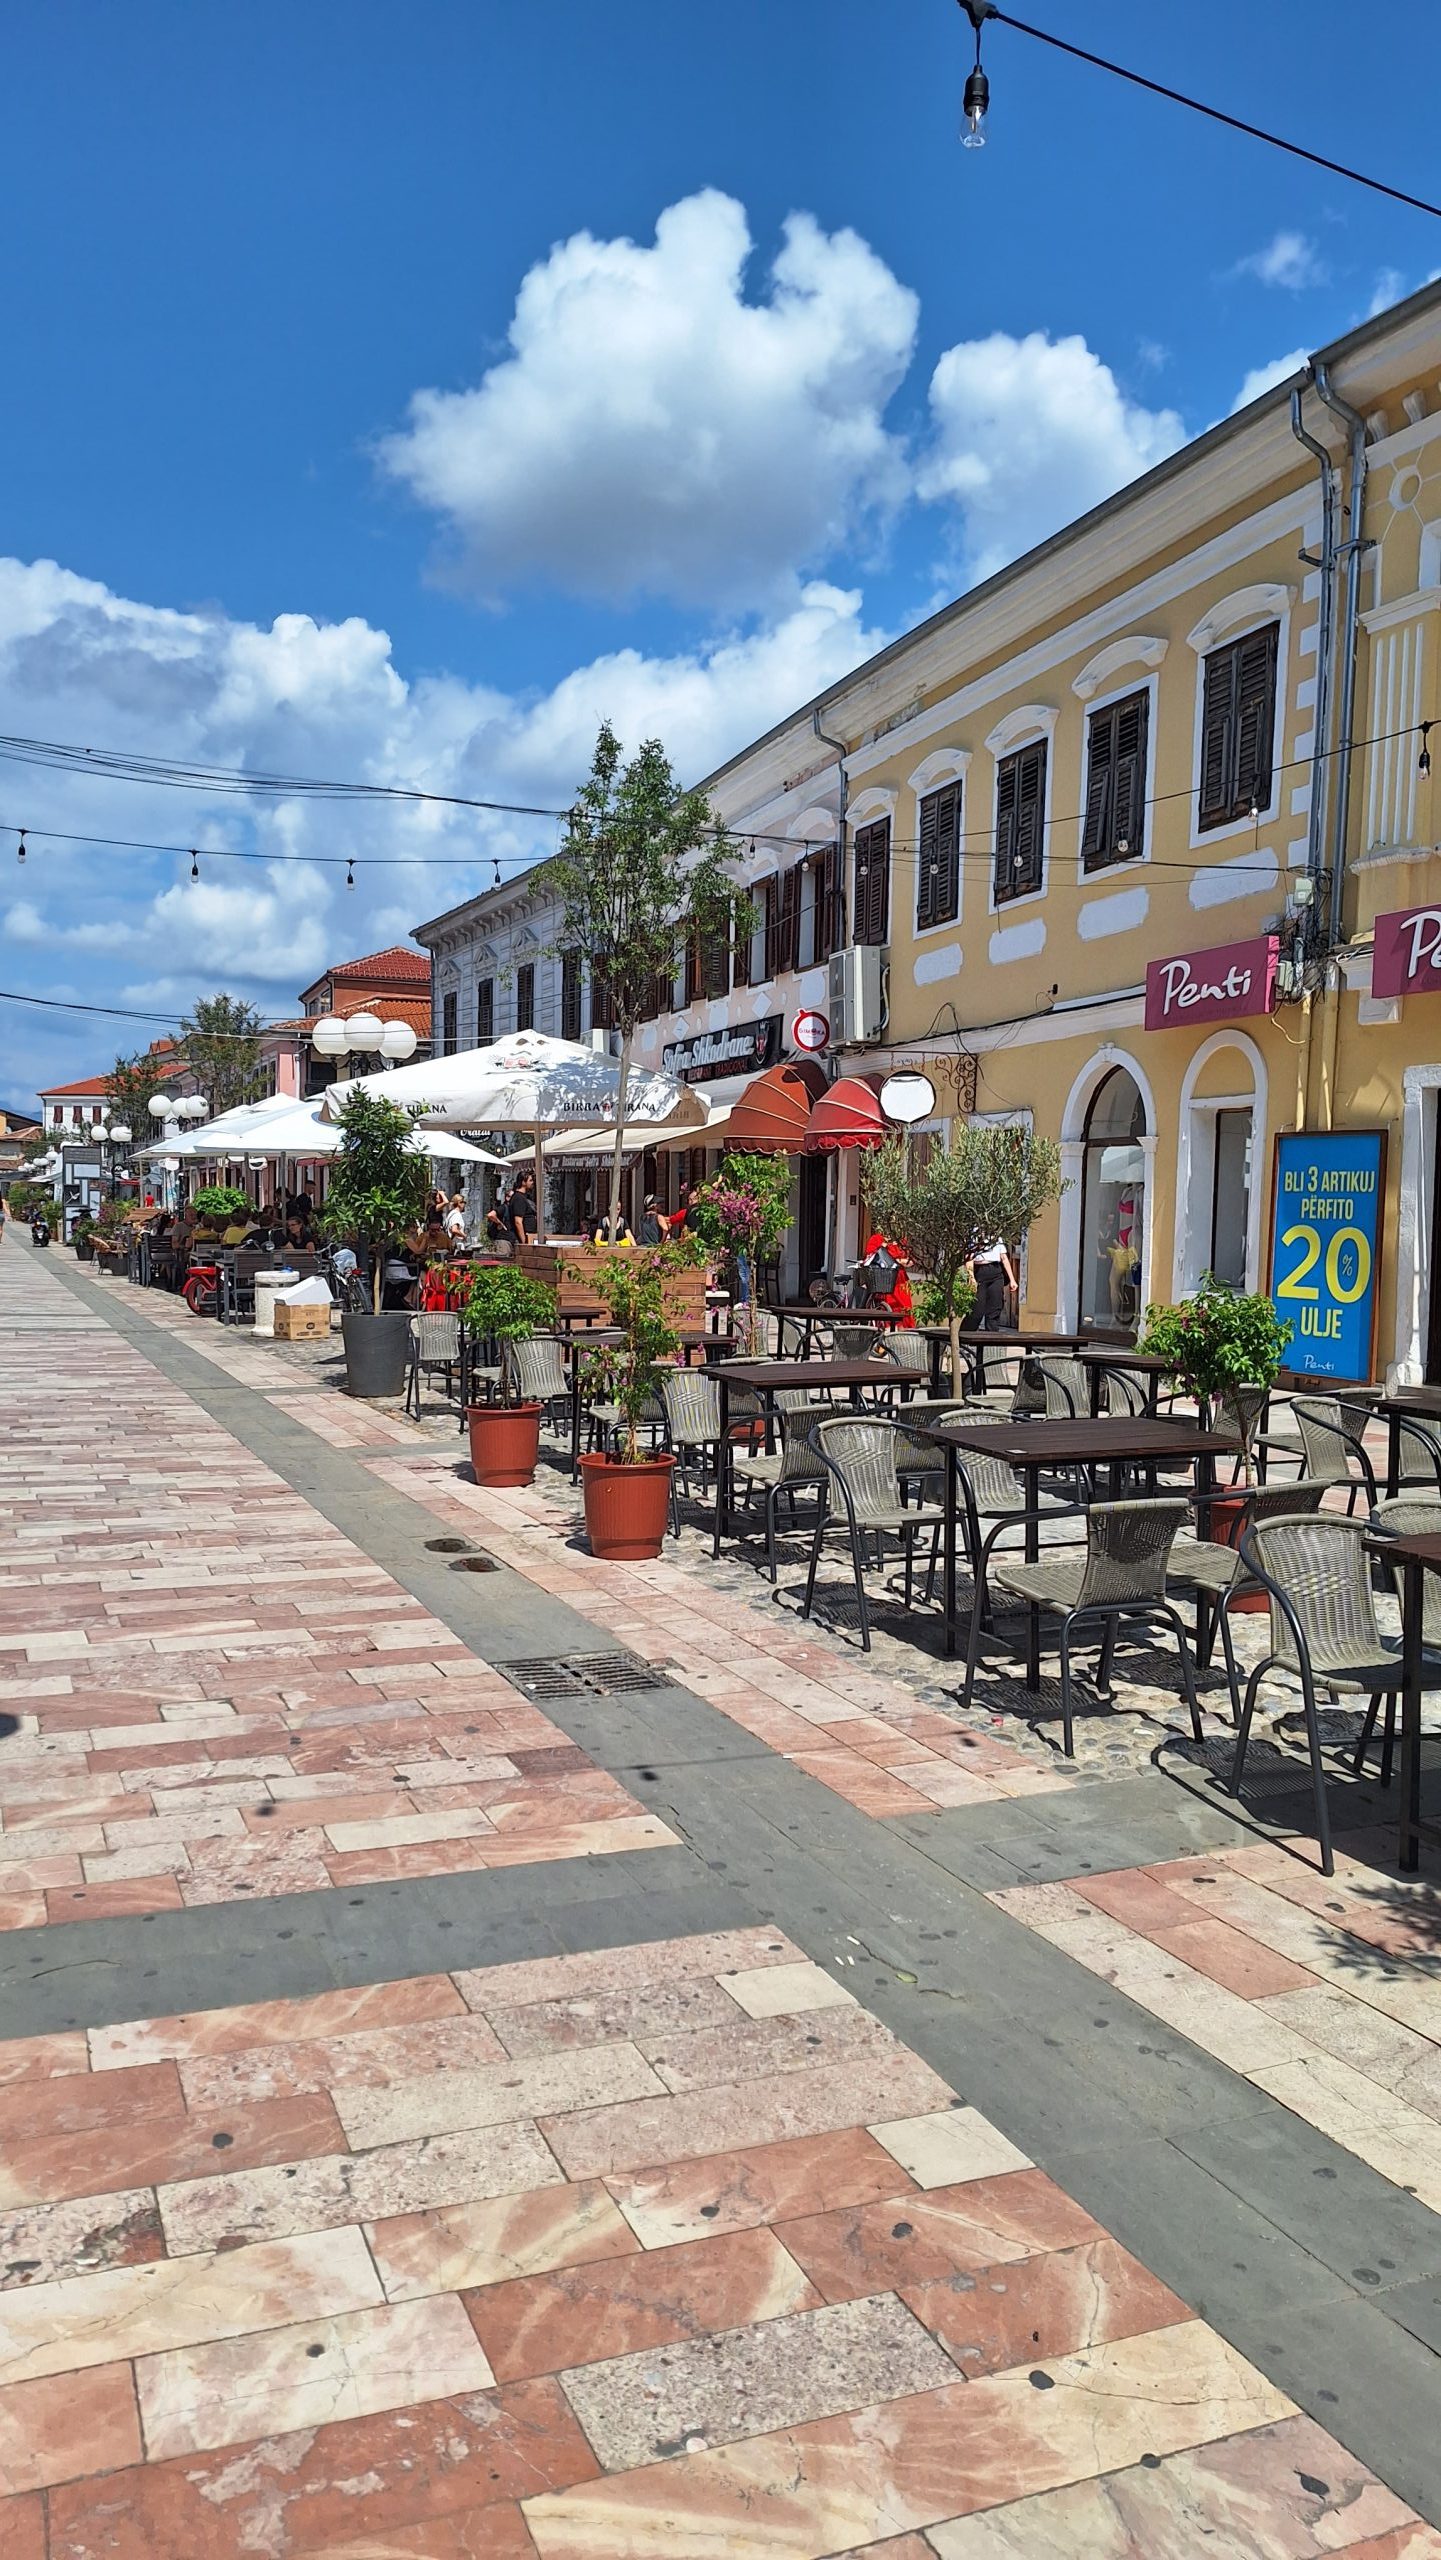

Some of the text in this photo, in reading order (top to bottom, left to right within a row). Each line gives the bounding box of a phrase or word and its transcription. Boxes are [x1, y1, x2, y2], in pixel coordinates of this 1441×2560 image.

[1160, 960, 1251, 1015] Penti
[692, 1030, 755, 1066] Shkodrane
[563, 1102, 600, 1112] BIRRA
[1284, 1166, 1375, 1193] BLI 3 ARTIKUJ
[1301, 1196, 1354, 1220] PËRFITO
[1277, 1224, 1371, 1304] 20
[1300, 1306, 1344, 1339] ULJE
[1303, 1354, 1336, 1371] Penti
